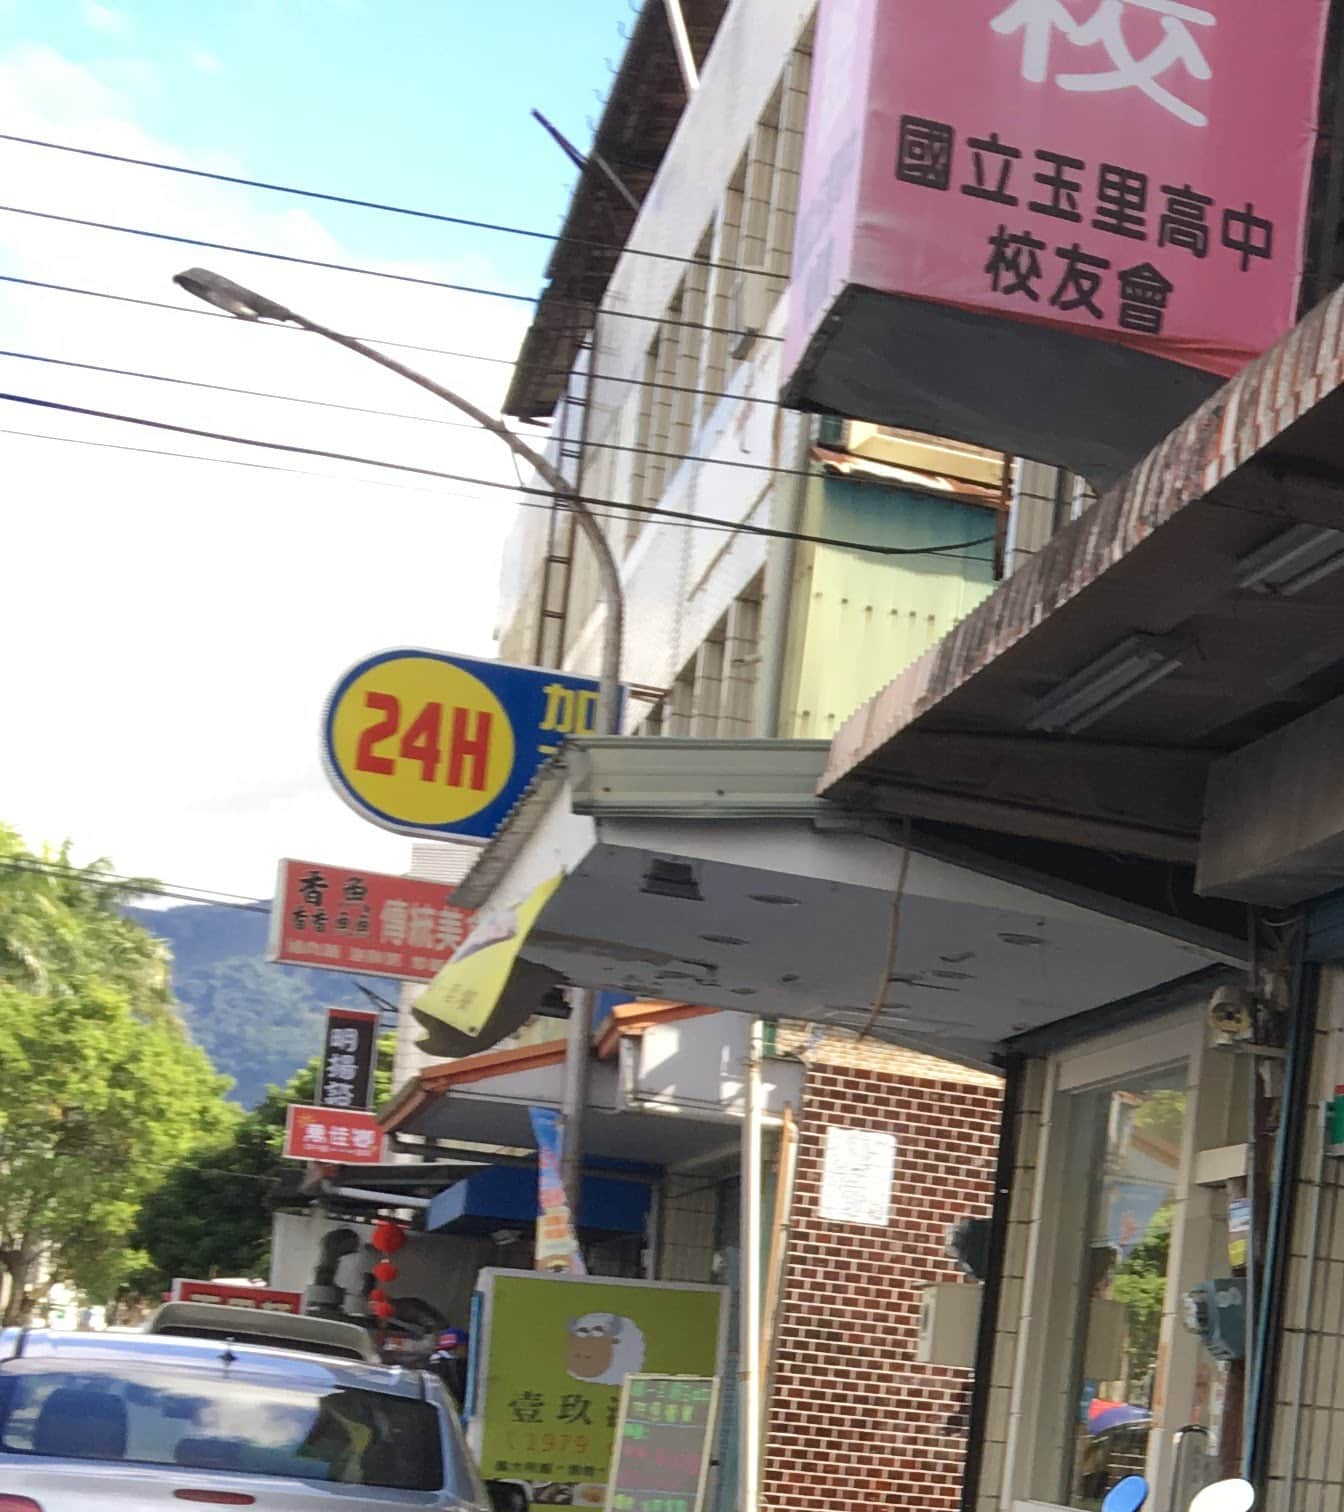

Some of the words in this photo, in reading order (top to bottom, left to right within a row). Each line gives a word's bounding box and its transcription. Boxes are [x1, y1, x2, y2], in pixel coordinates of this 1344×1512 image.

[989, 0, 1216, 127] 校
[896, 114, 1273, 273] 國立玉里高中
[985, 223, 1173, 335] 校友會
[355, 690, 495, 792] 24H
